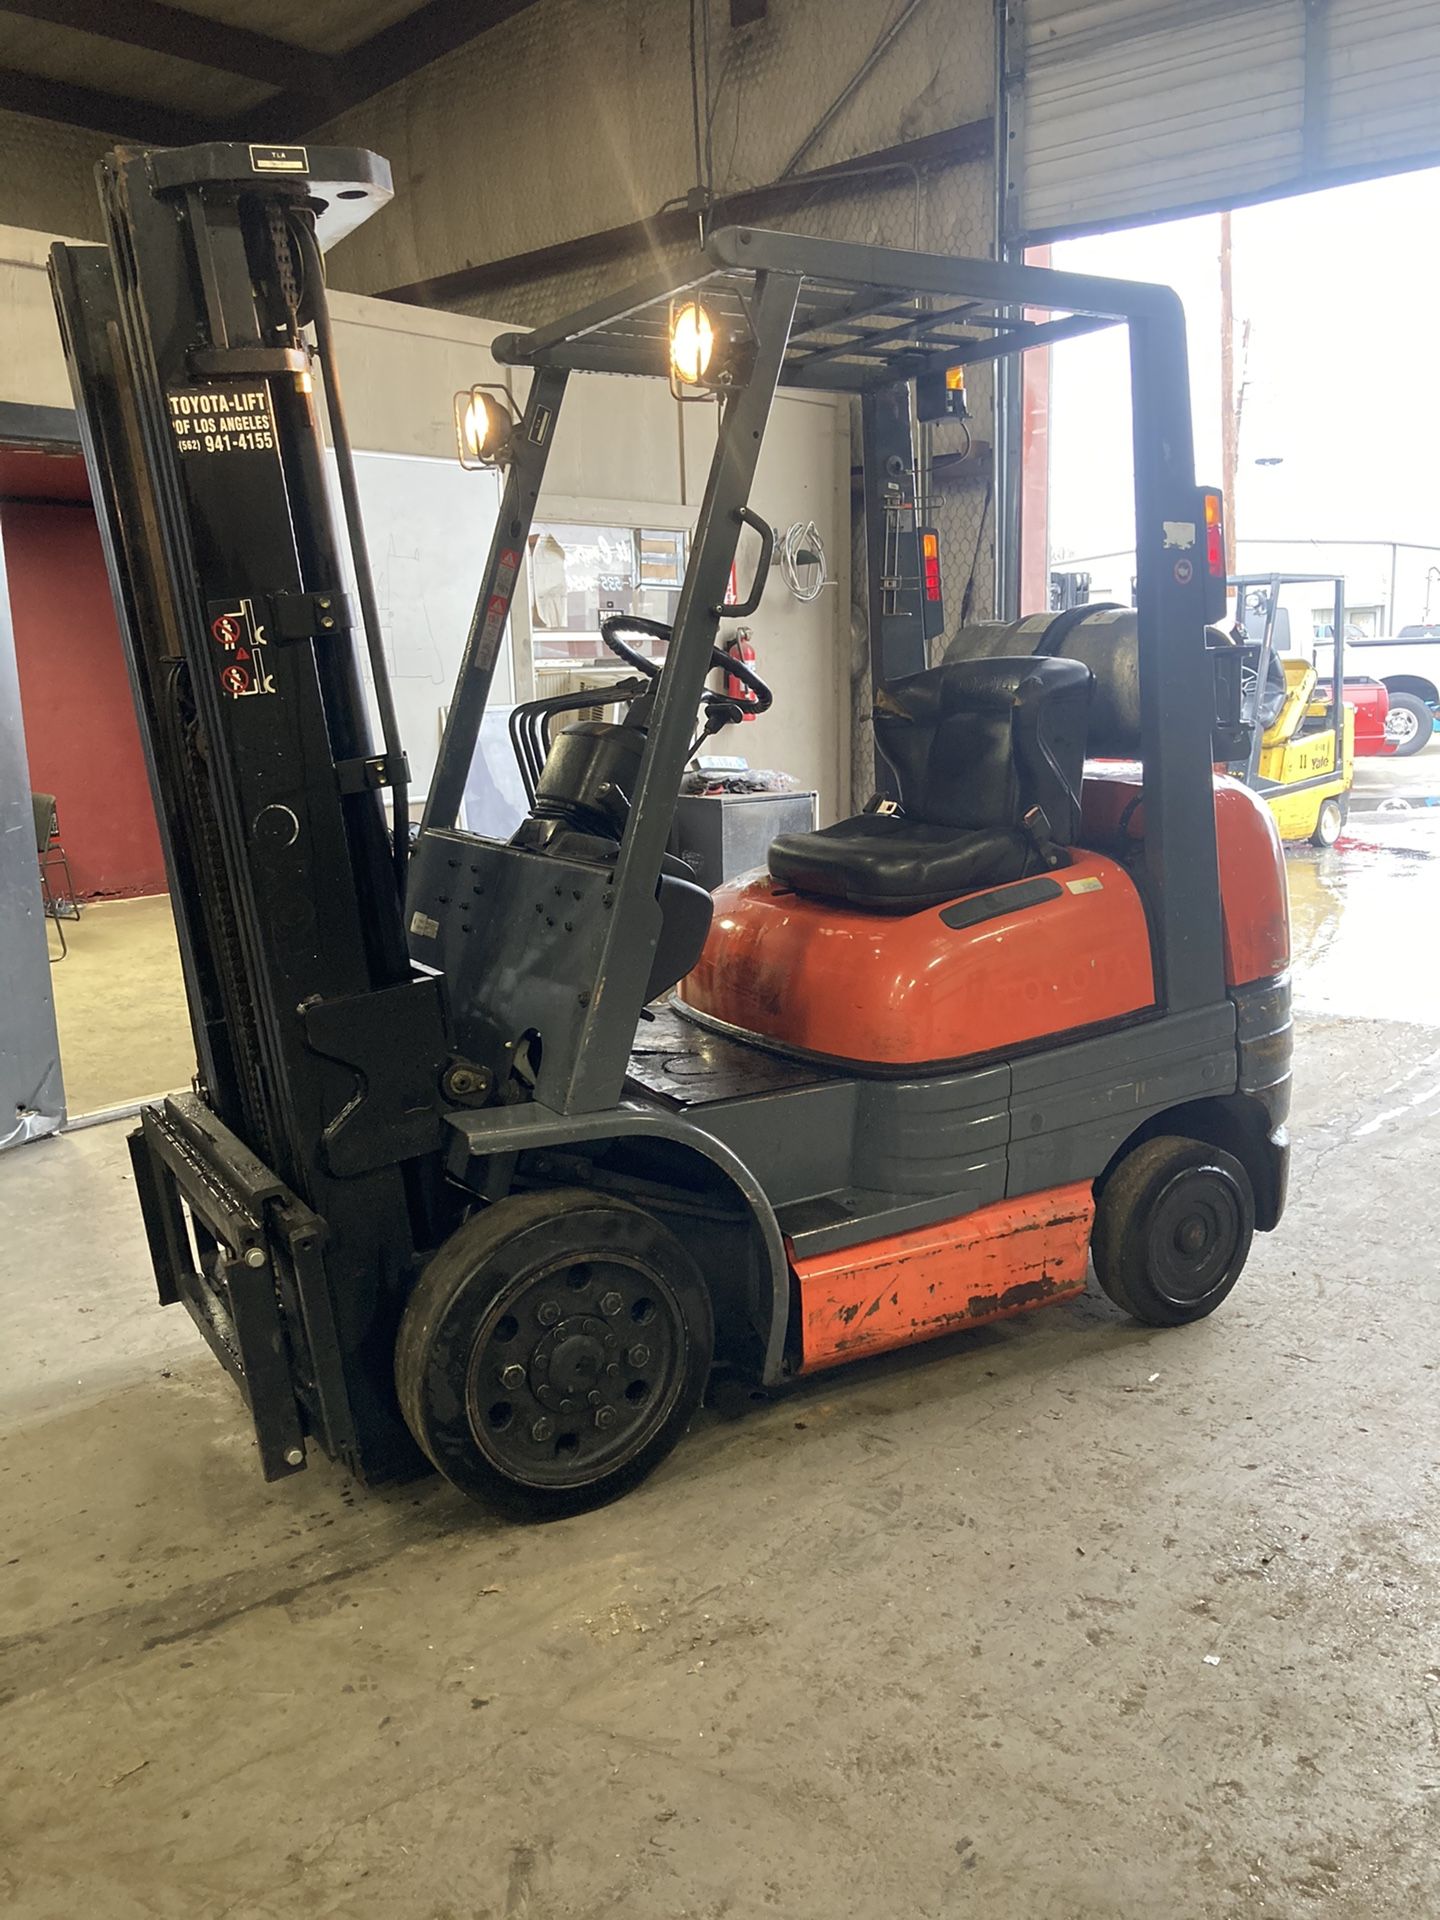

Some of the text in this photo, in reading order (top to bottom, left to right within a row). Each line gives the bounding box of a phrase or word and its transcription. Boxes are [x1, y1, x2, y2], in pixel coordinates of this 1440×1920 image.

[170, 393, 265, 415] TOYOTA-LIFT
[175, 415, 270, 435] OF LOS ANGELES
[179, 432, 273, 453] (562) 941-4155
